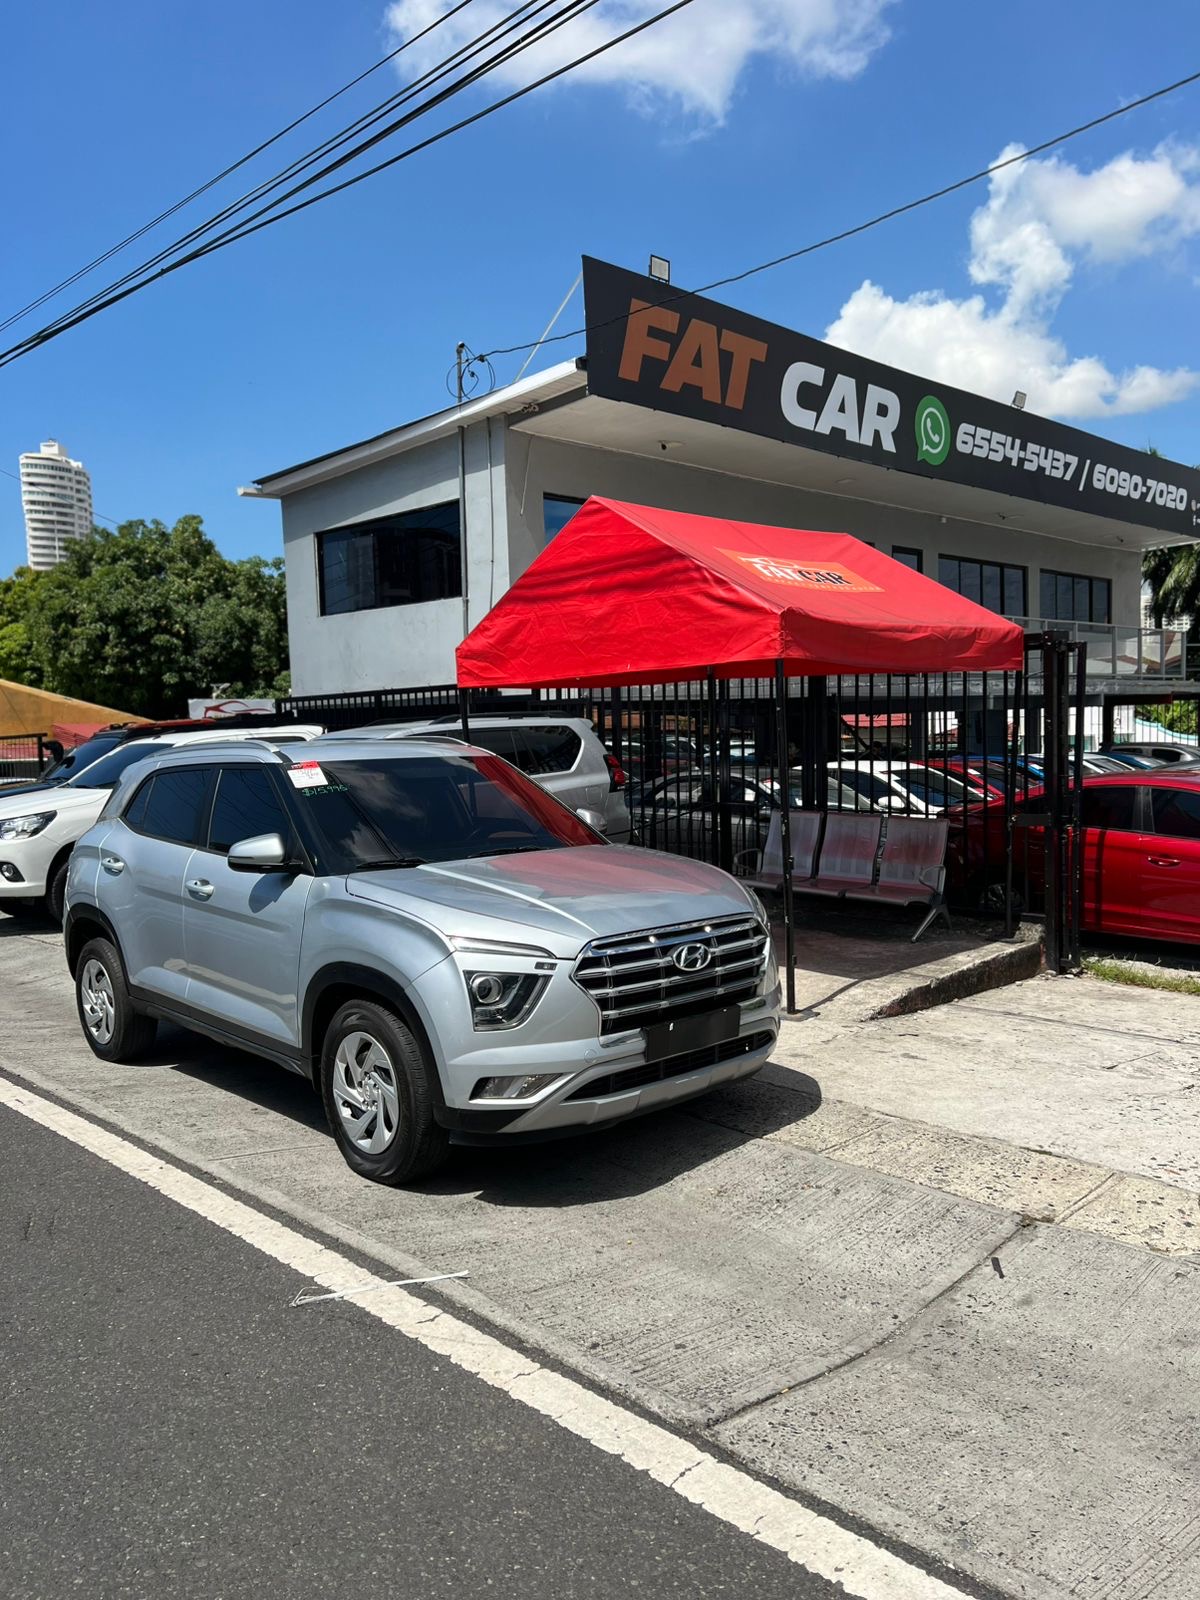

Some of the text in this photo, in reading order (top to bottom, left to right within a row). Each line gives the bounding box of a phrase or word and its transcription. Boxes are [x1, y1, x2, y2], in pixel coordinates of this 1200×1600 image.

[618, 298, 901, 454] FAT CAR
[955, 422, 1079, 481] 6554-5437
[1092, 463, 1188, 511] 6090-7020
